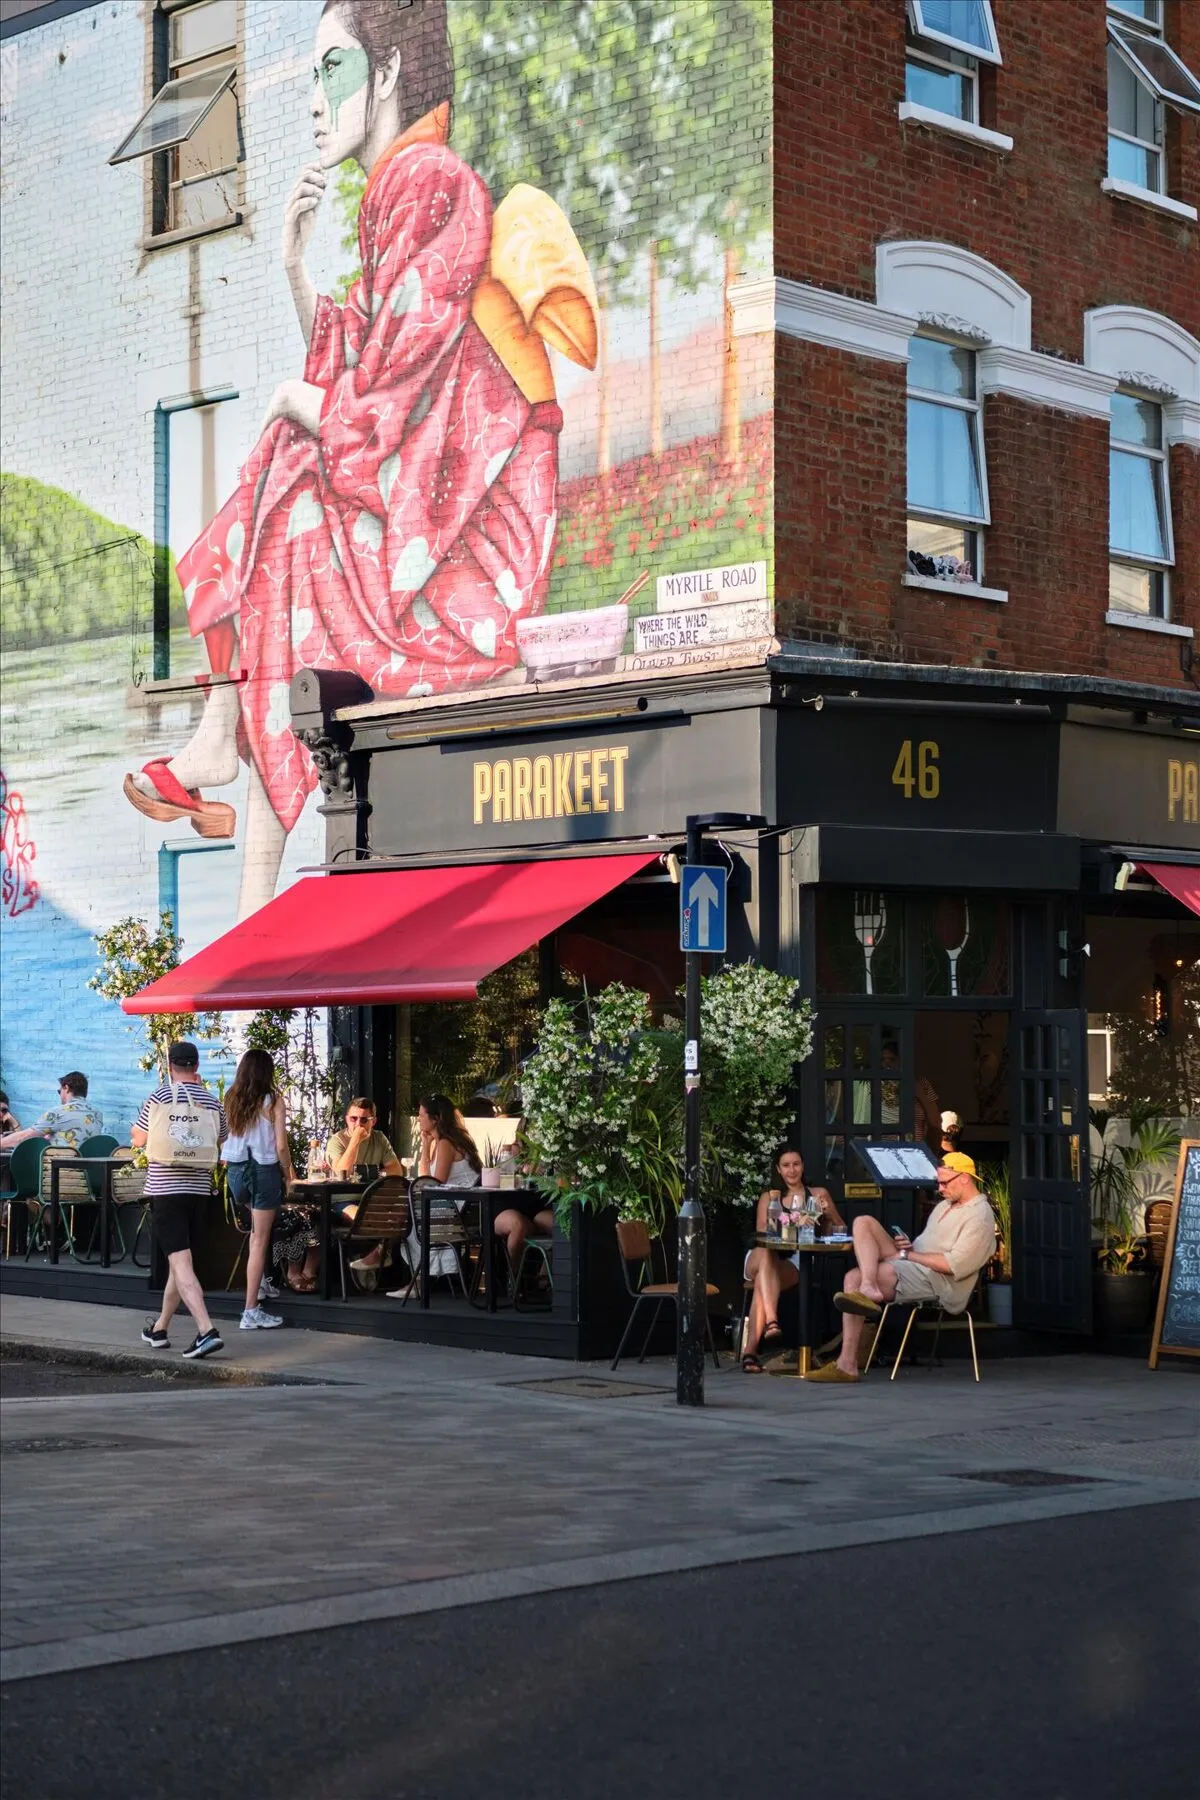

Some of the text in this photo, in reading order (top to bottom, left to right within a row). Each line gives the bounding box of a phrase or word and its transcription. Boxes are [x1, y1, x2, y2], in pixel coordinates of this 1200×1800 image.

[666, 567, 757, 596] MYRTLE ROAD
[638, 618, 664, 634] WHERE
[666, 616, 682, 630] THE
[643, 631, 676, 649] THINGS
[892, 740, 940, 799] 46
[473, 746, 628, 824] PARAKEET
[169, 1114, 199, 1123] crocs
